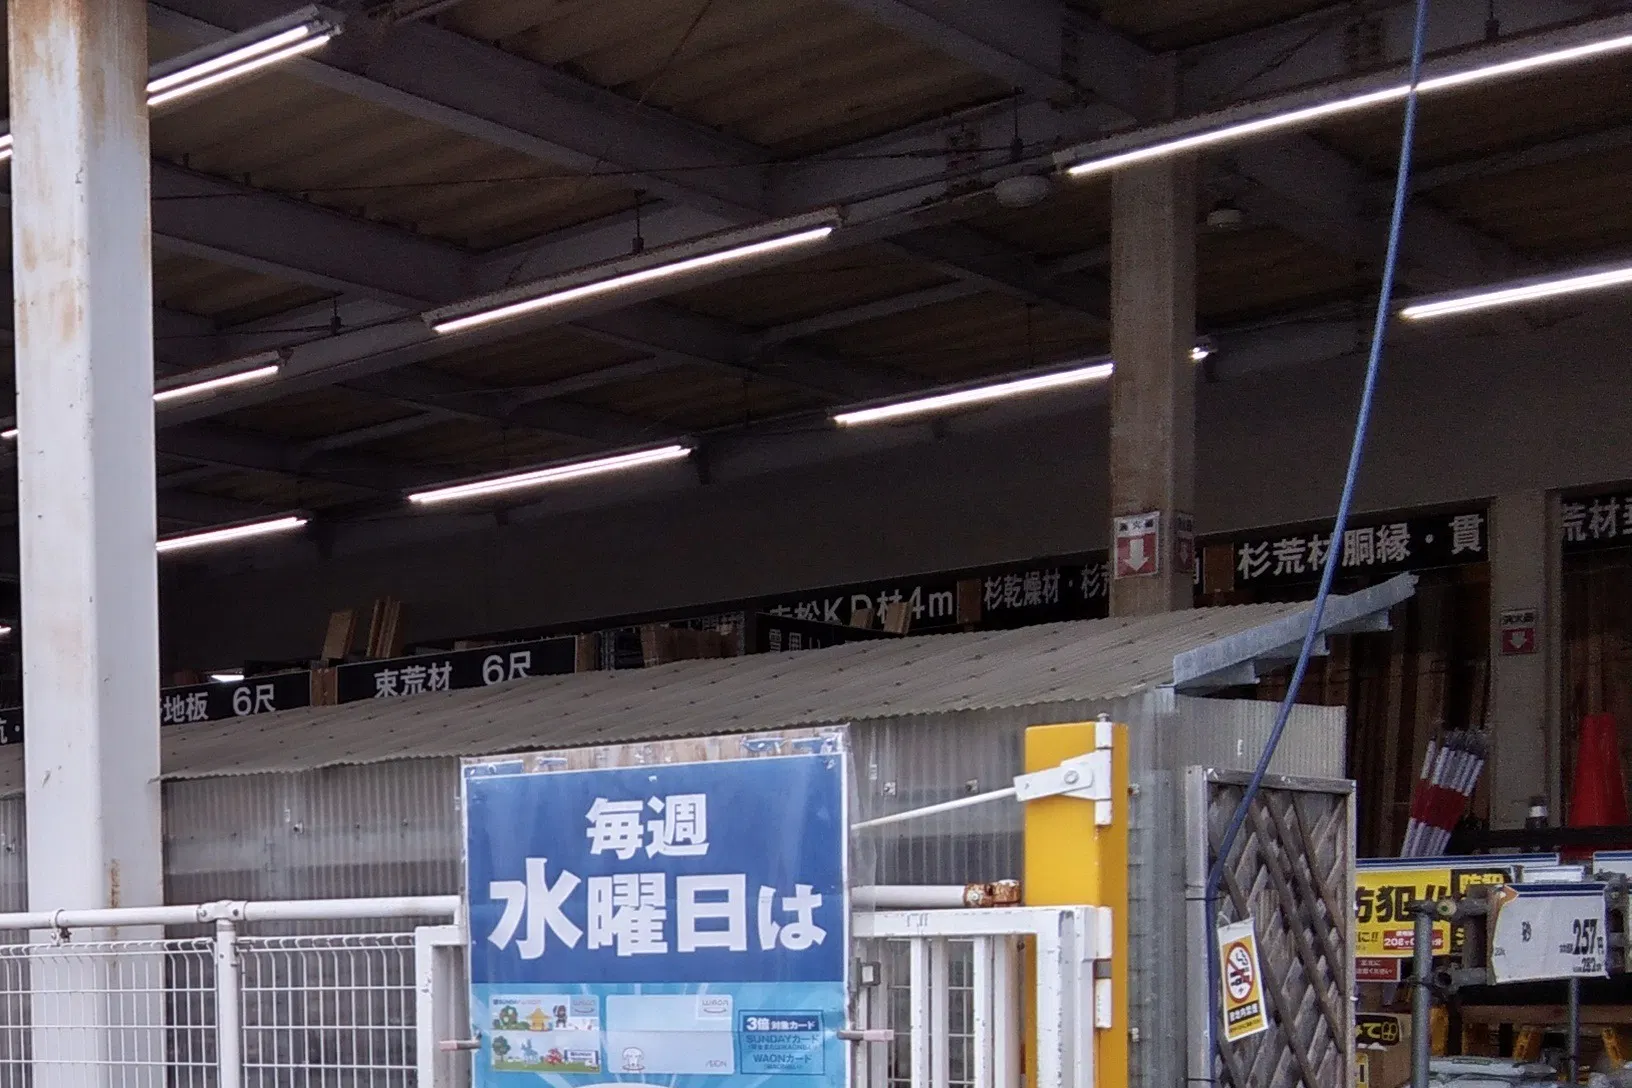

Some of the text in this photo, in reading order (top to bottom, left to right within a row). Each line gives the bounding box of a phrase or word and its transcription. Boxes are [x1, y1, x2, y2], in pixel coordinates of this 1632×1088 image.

[482, 650, 532, 686] 6尺
[232, 683, 277, 717] 6尺
[585, 792, 711, 860] 毎週
[486, 857, 829, 960] 水曜日は
